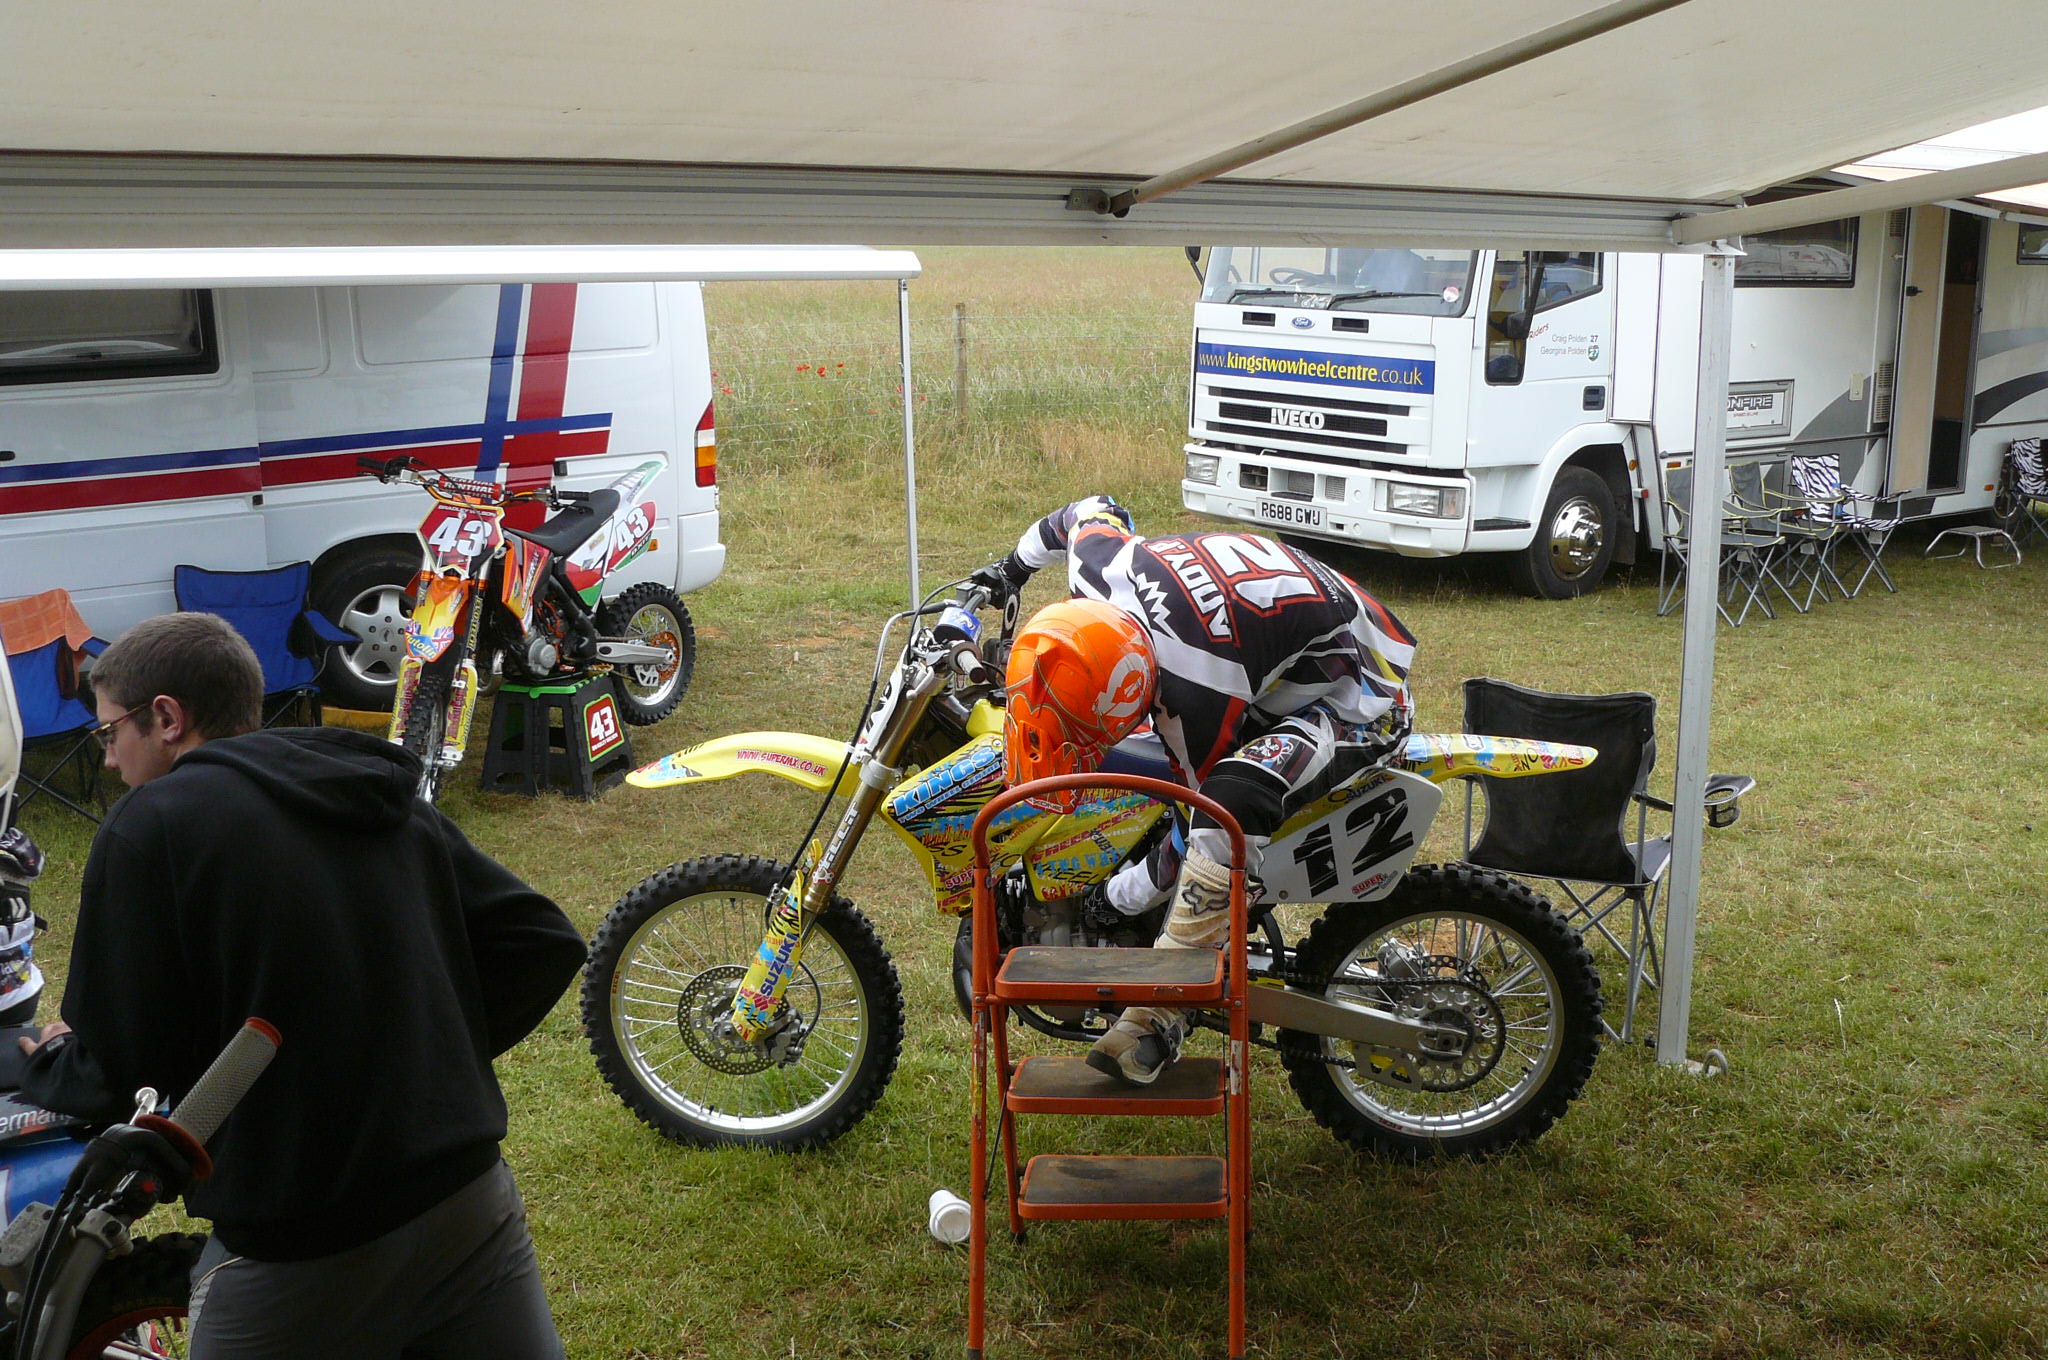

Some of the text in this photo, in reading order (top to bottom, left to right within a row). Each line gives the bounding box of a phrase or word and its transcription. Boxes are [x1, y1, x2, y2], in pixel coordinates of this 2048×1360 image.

[1590, 335, 1599, 343] 27
[1199, 352, 1424, 386] www.kingstwowheelcentre.co.uk
[1270, 408, 1325, 430] IVECO
[615, 507, 649, 551] 43
[1261, 502, 1320, 526] R688 GWU
[428, 516, 493, 557] 43
[1200, 534, 1318, 610] 12
[590, 706, 615, 741] 43
[893, 746, 996, 816] KINGS
[1293, 788, 1414, 898] 12
[760, 932, 798, 997] SUZUKI
